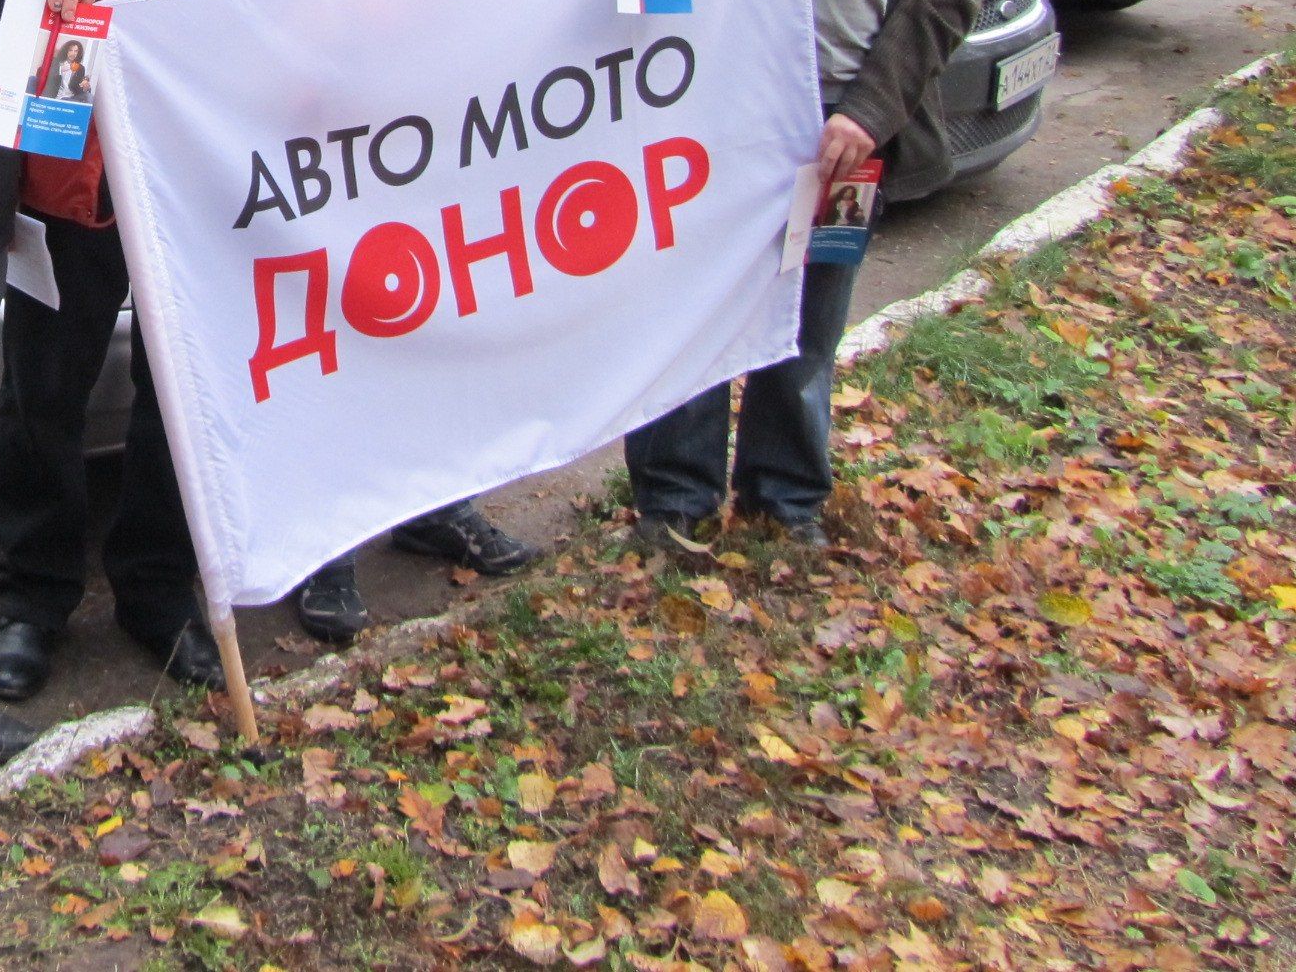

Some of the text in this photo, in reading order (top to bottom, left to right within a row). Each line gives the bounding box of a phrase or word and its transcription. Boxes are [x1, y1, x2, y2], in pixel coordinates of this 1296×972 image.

[232, 36, 695, 229] АВТО МОТО
[248, 136, 710, 404] ДОНОР
